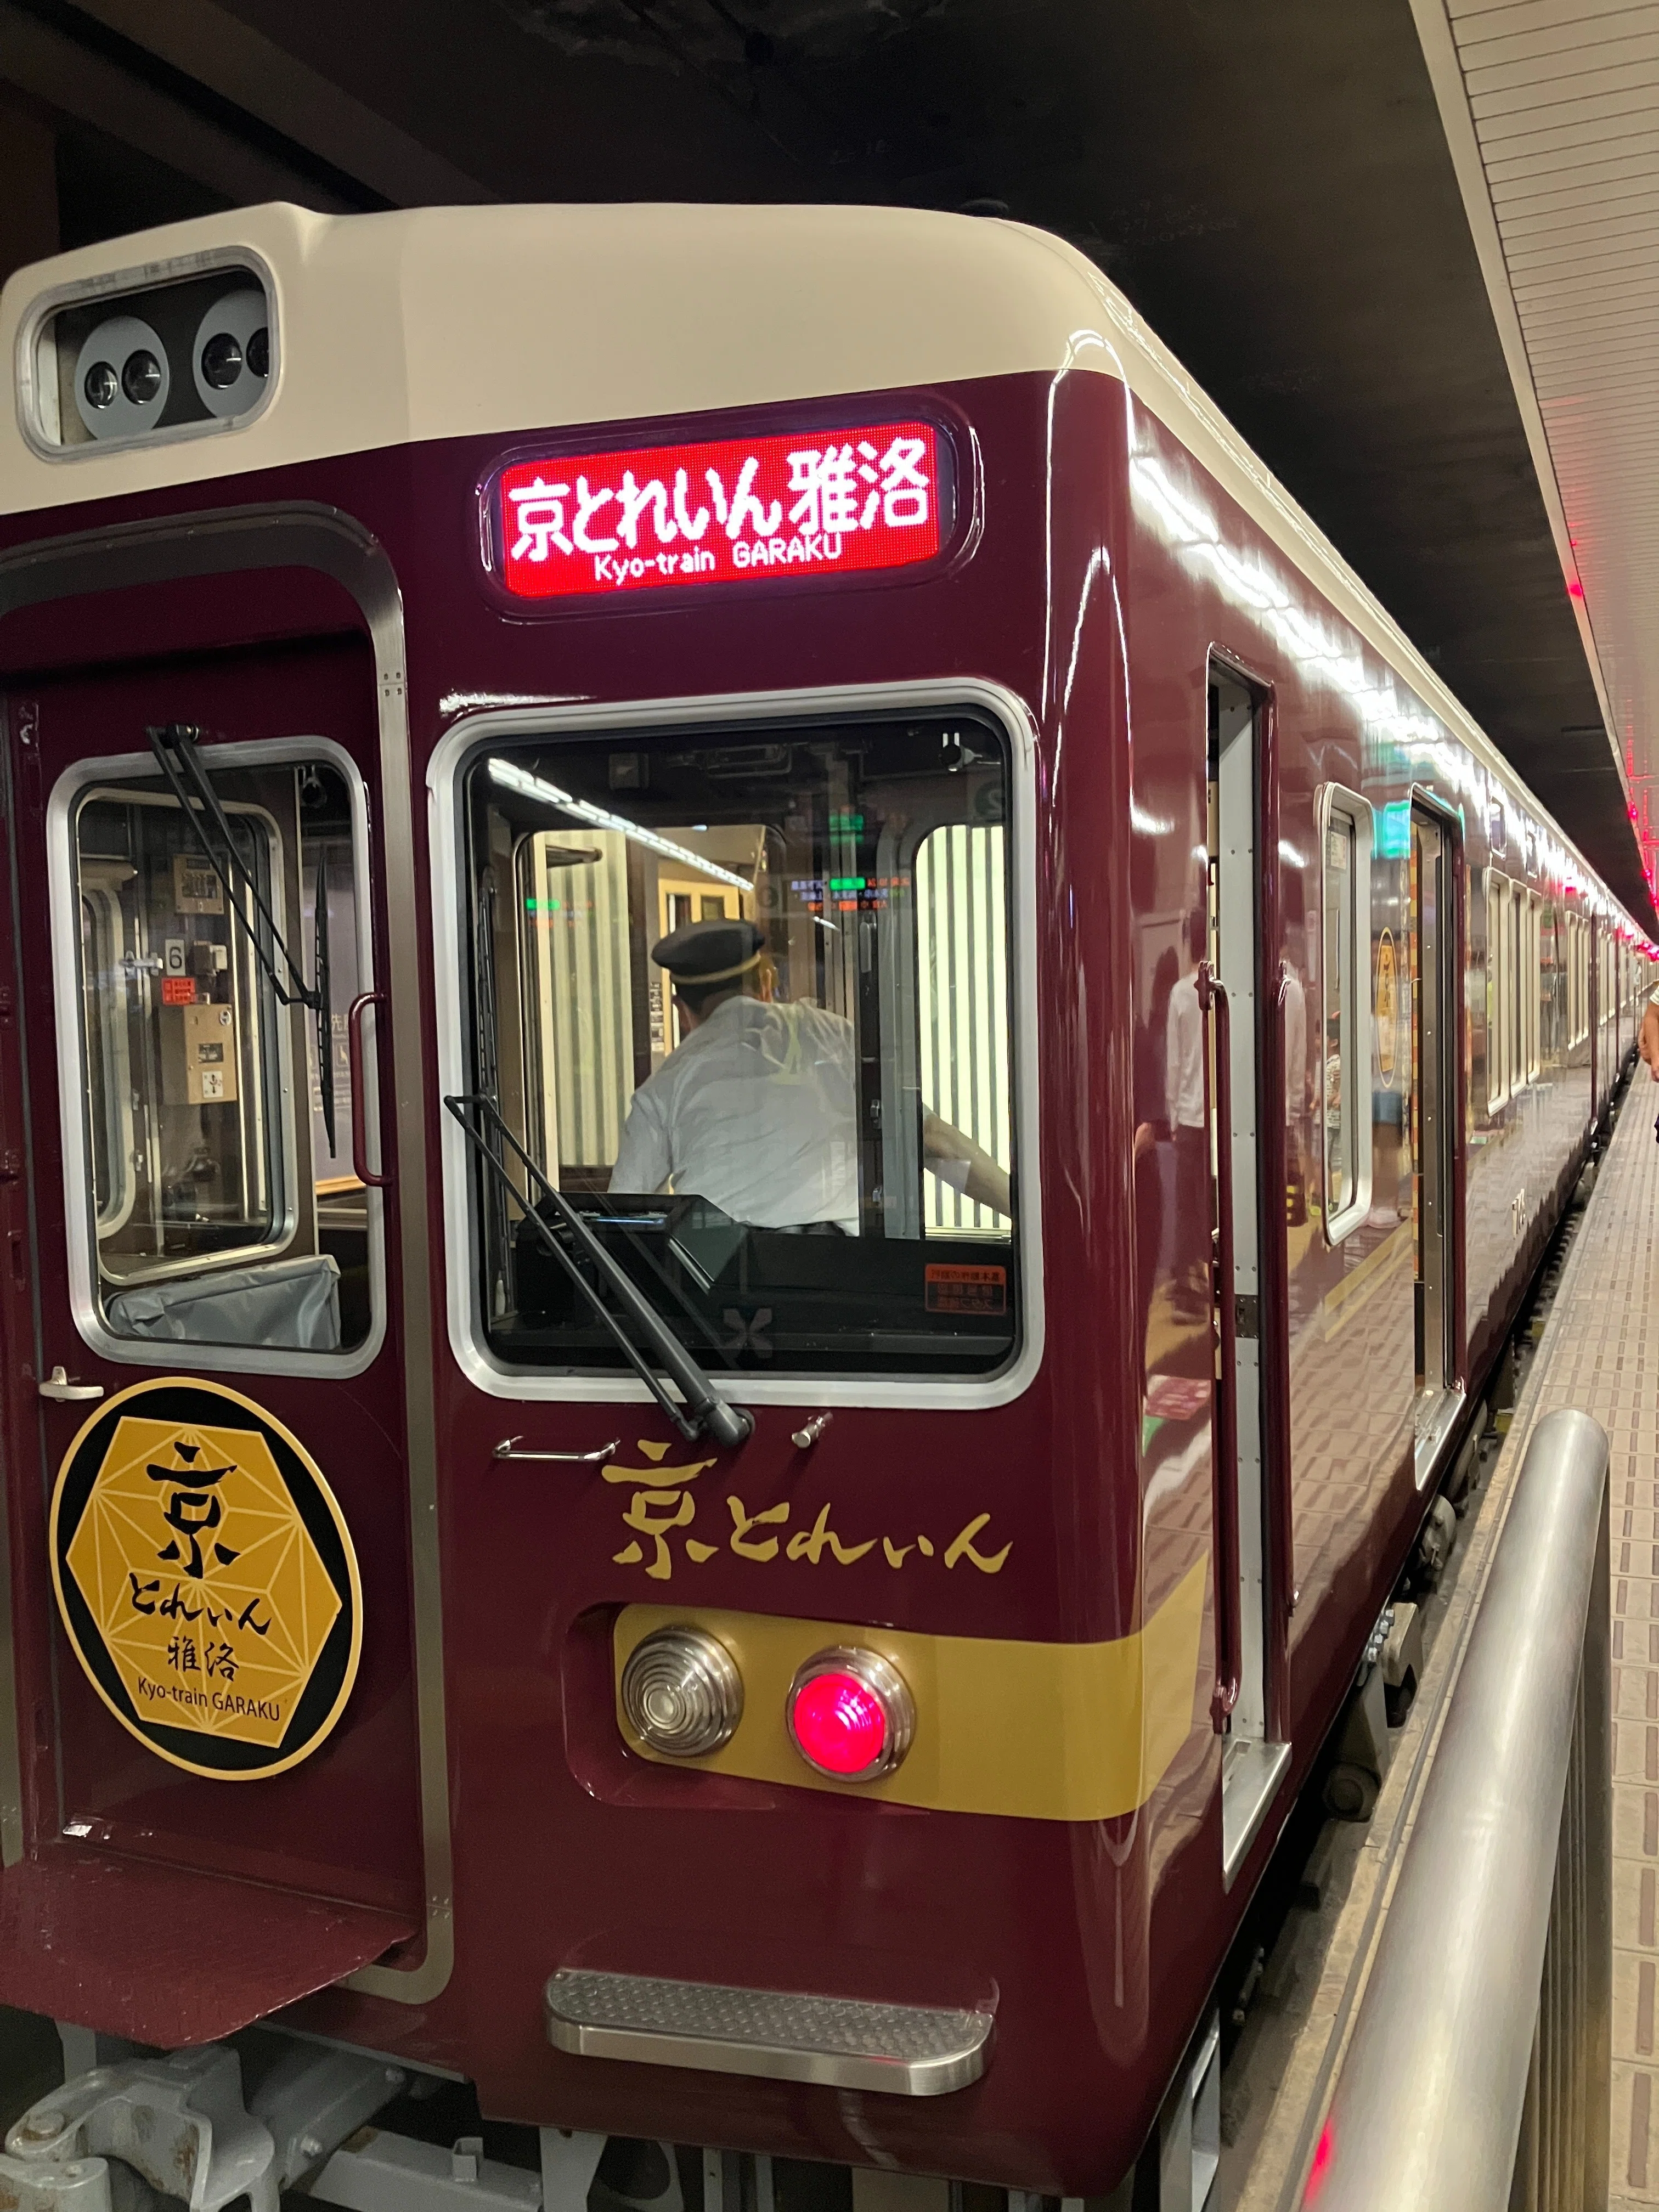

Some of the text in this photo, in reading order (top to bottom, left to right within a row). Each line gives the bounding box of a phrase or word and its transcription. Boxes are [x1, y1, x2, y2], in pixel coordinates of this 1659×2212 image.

[594, 532, 843, 586] Kyo-train GARAKU
[169, 946, 183, 970] 6
[146, 1441, 241, 1579] 京
[601, 1439, 1013, 1579] 京とれいん
[128, 1572, 271, 1635] とれいん
[167, 1634, 240, 1683] 雅洛
[138, 1677, 281, 1722] Kyo-train GARAKU
